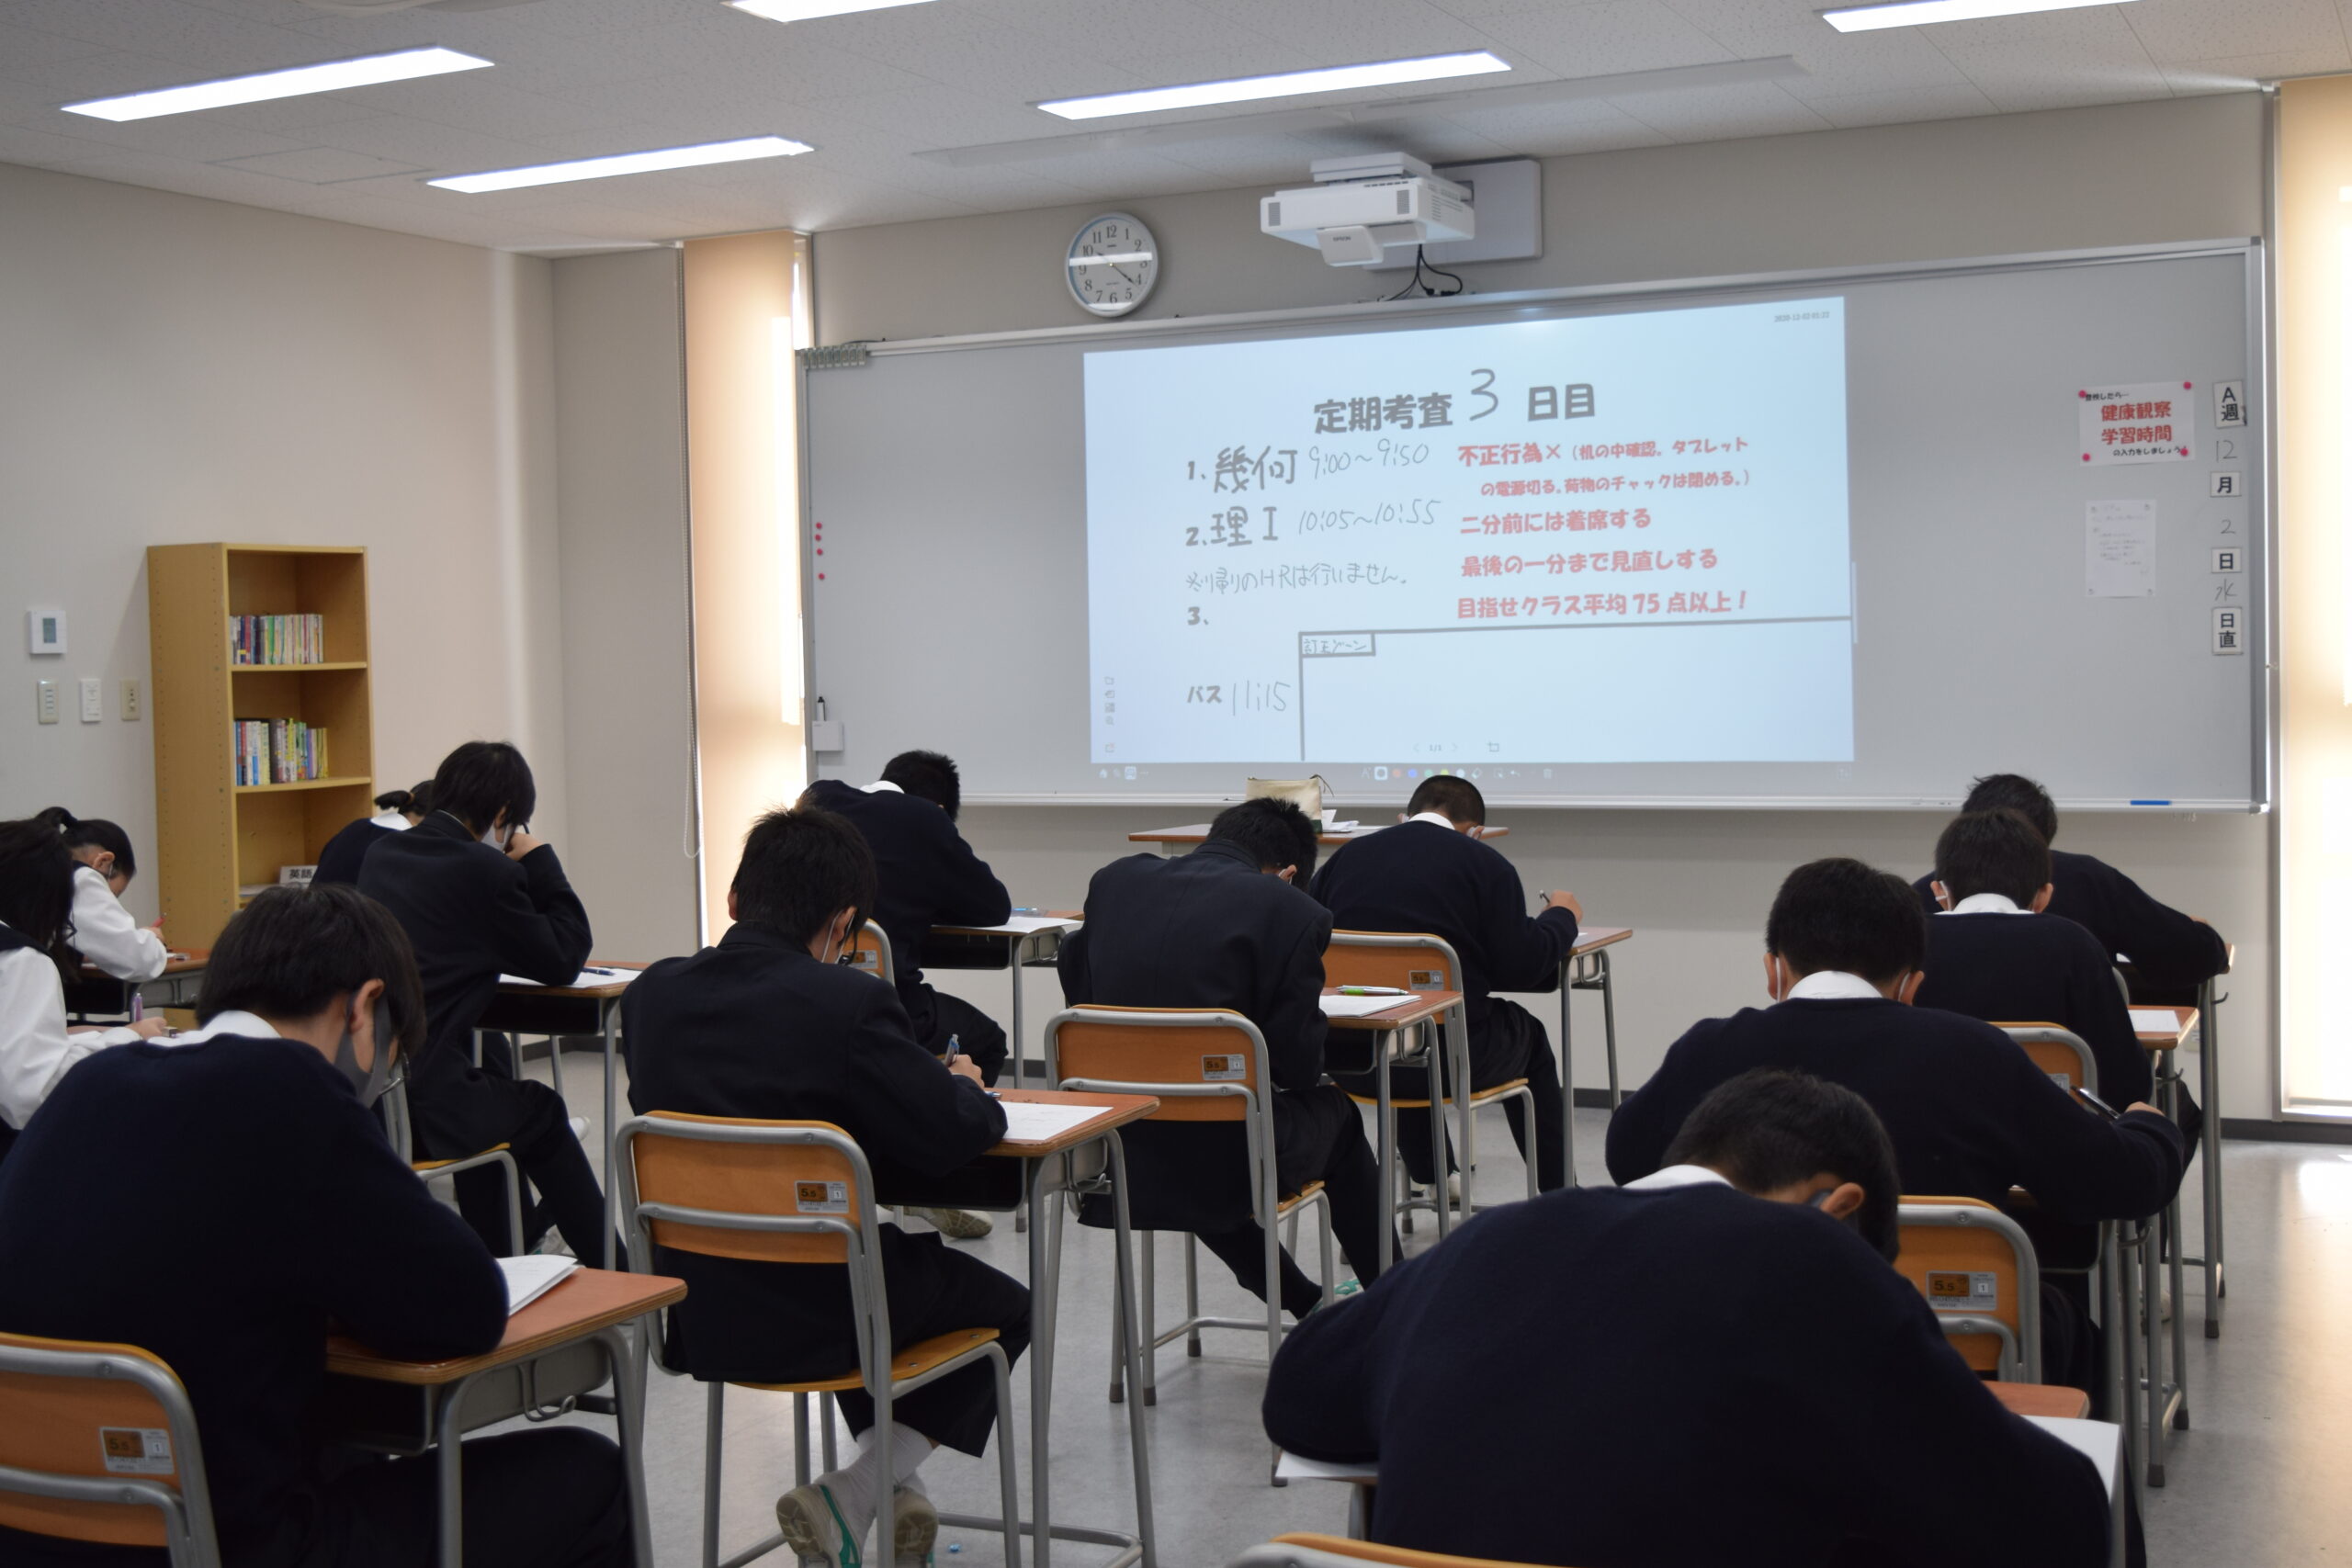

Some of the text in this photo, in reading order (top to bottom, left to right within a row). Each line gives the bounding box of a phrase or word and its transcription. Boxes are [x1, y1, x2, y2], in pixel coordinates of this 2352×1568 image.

[1093, 231, 1101, 243] 11
[1106, 225, 1116, 238] 12
[1125, 228, 1129, 240] 1
[1083, 245, 1093, 256] 10
[1135, 240, 1142, 251] 2
[1079, 265, 1087, 275] 9
[1085, 279, 1092, 291] 8
[1136, 274, 1141, 285] 4
[1096, 290, 1102, 301] 7
[1109, 292, 1117, 303] 6
[1125, 288, 1132, 299] 5
[1314, 368, 1595, 434] 定期考査 3 日目
[2101, 400, 2172, 422] 健康観察
[2101, 424, 2173, 446] 学習時間
[2113, 445, 2187, 457] の入力をしましょう
[2216, 440, 2237, 462] 12
[1214, 446, 1297, 493] 幾何
[2217, 477, 2233, 493] 月
[1461, 508, 1651, 535] 二分前には着席する
[2220, 519, 2236, 535] 2
[1461, 548, 1717, 577] 最後の一分まで見直しする
[2219, 553, 2233, 570] 日
[2214, 579, 2237, 602] 水
[2218, 613, 2237, 649] 日直
[1187, 680, 1291, 716] バス 11:15
